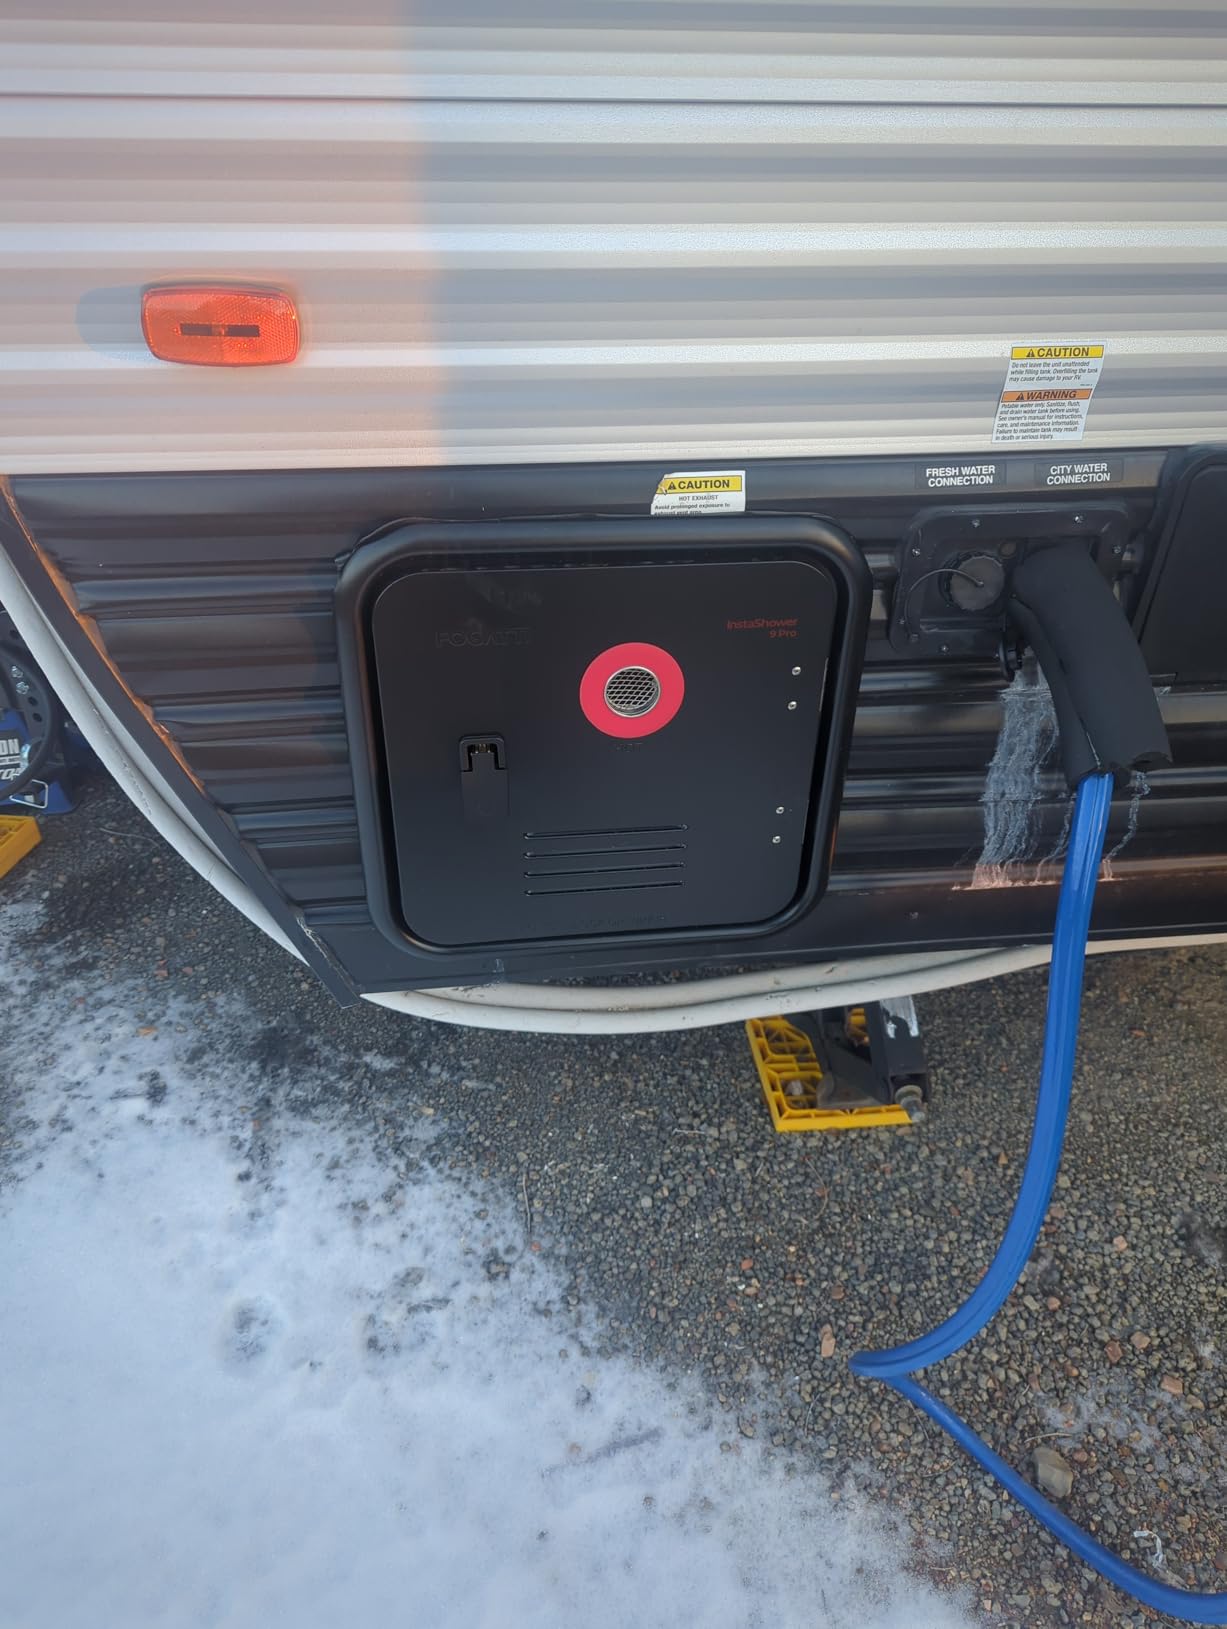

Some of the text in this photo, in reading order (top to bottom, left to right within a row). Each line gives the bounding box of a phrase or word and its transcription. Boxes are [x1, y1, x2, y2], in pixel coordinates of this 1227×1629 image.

[1037, 348, 1090, 358] CAUTION
[1026, 390, 1077, 400] WARNING
[926, 465, 996, 478] FRESH WATER
[1050, 462, 1108, 475] CITY WATER
[928, 475, 994, 488] CONNECTION
[1046, 472, 1111, 485] CONNECTION
[678, 480, 730, 490] CAUTION
[726, 618, 798, 630] InstaShower
